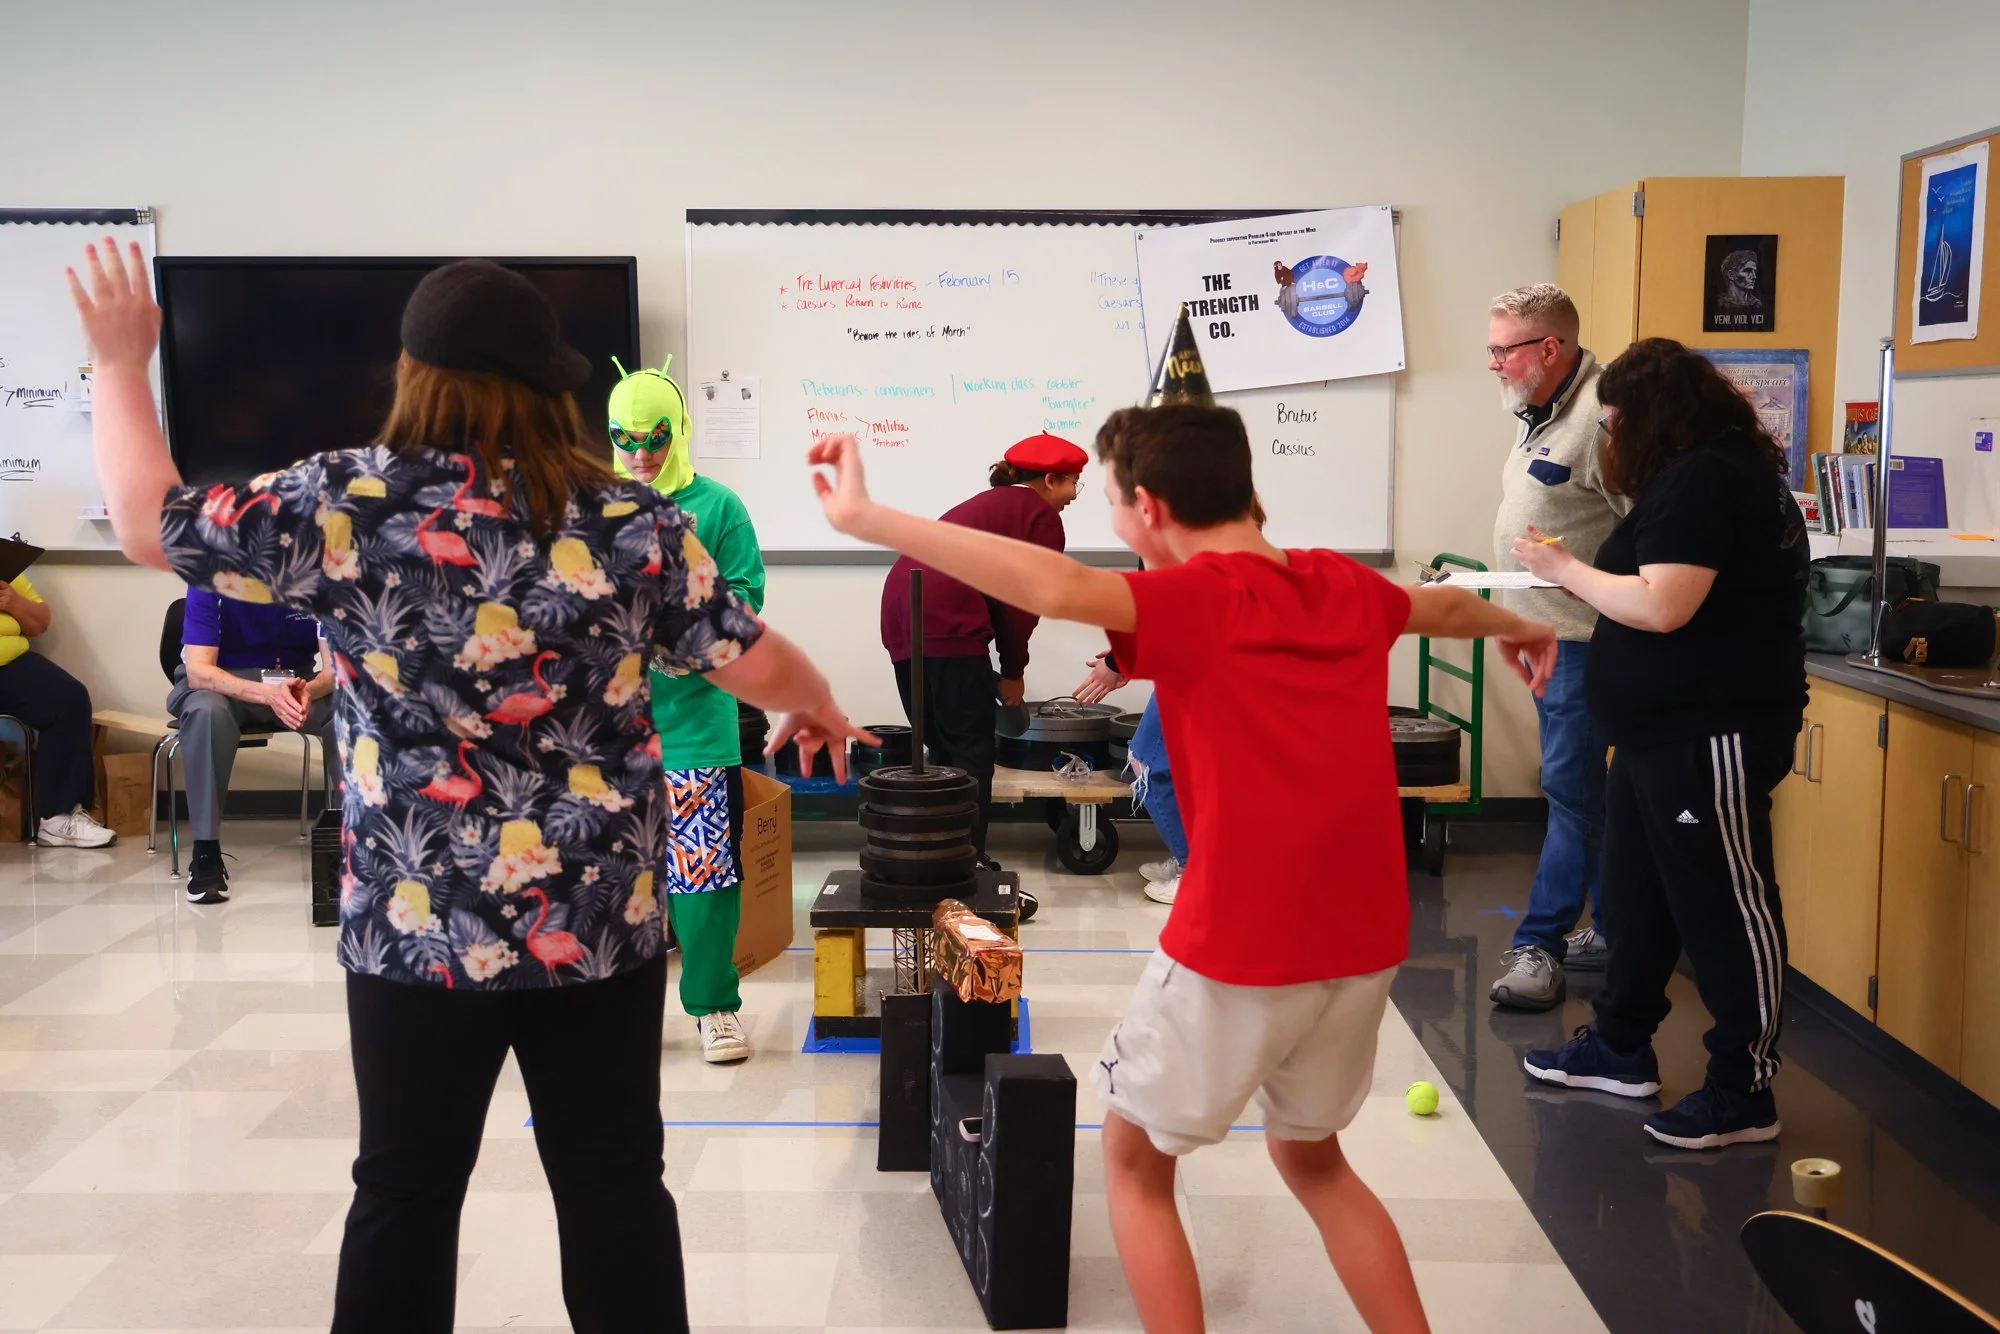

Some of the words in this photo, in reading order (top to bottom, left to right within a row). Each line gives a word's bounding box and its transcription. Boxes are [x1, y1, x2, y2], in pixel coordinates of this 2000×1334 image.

[1002, 269, 1020, 286] 15
[1202, 273, 1232, 292] THE
[1302, 278, 1339, 292] H&C
[1303, 303, 1343, 313] BARBELL
[1312, 310, 1336, 318] CLUB
[1209, 321, 1235, 339] CO.
[1298, 321, 1336, 335] ESTABLISHED
[1732, 377, 1789, 388] hakespeare
[1277, 402, 1318, 424] Brutus
[1272, 438, 1316, 456] Cassius
[758, 812, 777, 836] Berry
